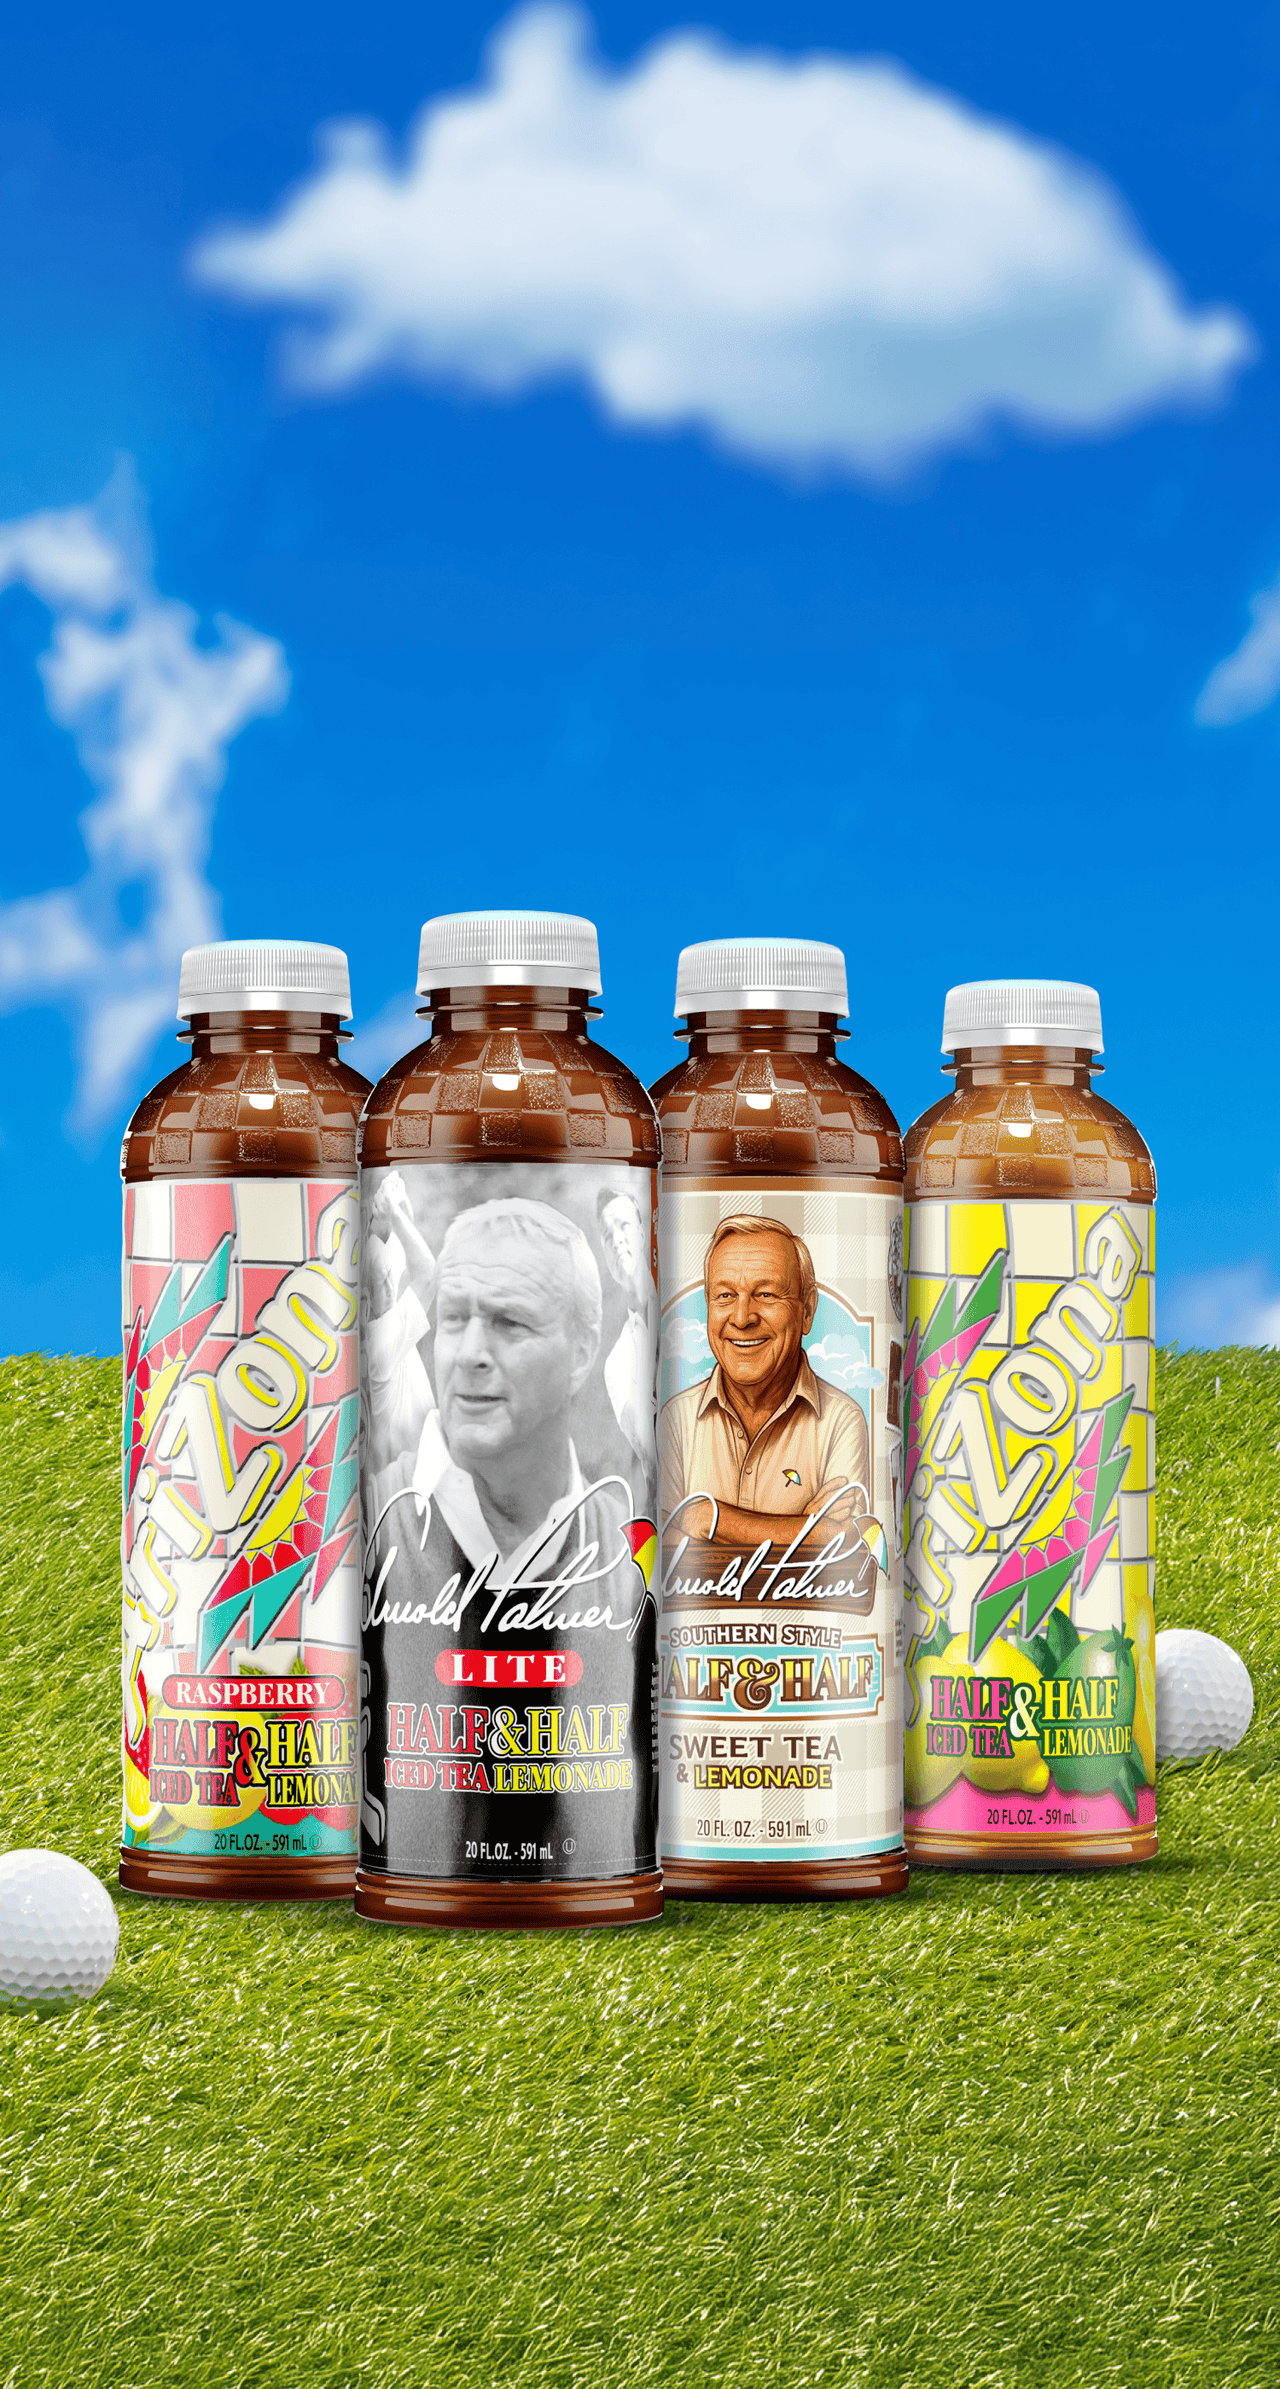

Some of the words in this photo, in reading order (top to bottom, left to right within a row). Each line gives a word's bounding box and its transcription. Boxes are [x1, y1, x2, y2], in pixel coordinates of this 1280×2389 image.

[480, 1475, 634, 1633] Palmer
[757, 1481, 870, 1601] Palmer
[669, 1623, 777, 1648] SOUTHERN
[781, 1624, 842, 1649] STYLE
[451, 1653, 566, 1683] LITE
[176, 1681, 330, 1705] RASPBERRY
[930, 1675, 1013, 1723] HALF
[1006, 1682, 1041, 1741] &
[1039, 1675, 1119, 1722] HALF
[153, 1718, 239, 1769] HALF
[233, 1727, 269, 1788] &
[265, 1720, 359, 1769] HALF
[669, 1733, 772, 1760] SWEET
[783, 1734, 842, 1761] TEA
[926, 1723, 968, 1757] ICED
[969, 1725, 1015, 1759] TEA
[1040, 1724, 1133, 1759] LEMONADE
[149, 1768, 193, 1803] ICED
[195, 1771, 241, 1808] TEA
[266, 1772, 359, 1807] LEMONA
[385, 1758, 436, 1790] ICED
[437, 1761, 492, 1793] TEA
[493, 1759, 634, 1793] LEMONADE
[676, 1762, 689, 1783] &
[694, 1764, 833, 1789] LEMONADE
[697, 1818, 711, 1837] 20
[767, 1820, 791, 1838] 591
[795, 1819, 812, 1837] mL
[987, 1809, 1000, 1825] 20
[1045, 1809, 1062, 1825] 591
[1064, 1809, 1077, 1824] mL
[214, 1833, 227, 1850] 20
[272, 1834, 290, 1851] 591
[292, 1834, 307, 1850] mL
[465, 1841, 478, 1859] 20
[520, 1842, 537, 1860] 591
[539, 1842, 553, 1860] mL
